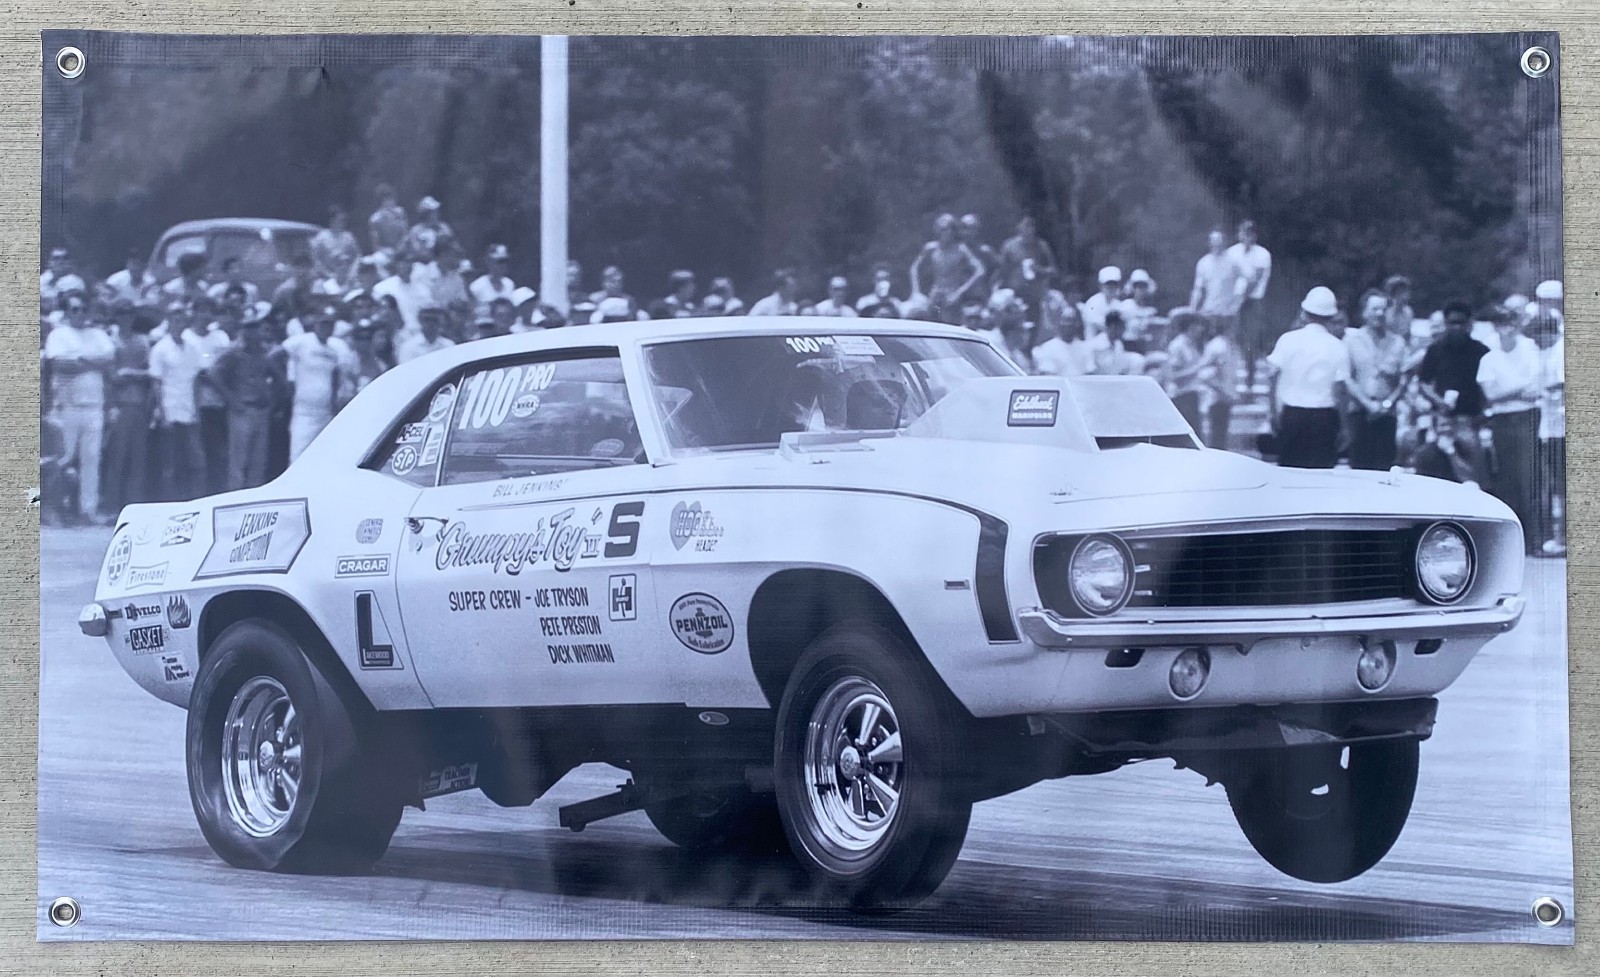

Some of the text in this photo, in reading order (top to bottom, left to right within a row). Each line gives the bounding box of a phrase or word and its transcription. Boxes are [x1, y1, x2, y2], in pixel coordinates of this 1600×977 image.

[786, 337, 820, 353] 100
[458, 366, 522, 430] 100
[520, 363, 556, 392] PRO
[394, 448, 415, 467] STP
[493, 482, 513, 497] BILL
[234, 511, 279, 542] JENKINS
[339, 559, 387, 572] CRAGAR
[449, 590, 486, 611] SUPER
[490, 589, 521, 610] CREW
[534, 588, 551, 608] JOE
[551, 587, 589, 607] TRYSON
[539, 615, 602, 636] PETE PRESTON
[676, 615, 728, 633] PENNZOIL
[132, 626, 162, 649] GASKET
[547, 643, 615, 664] DICK WHITMAN
